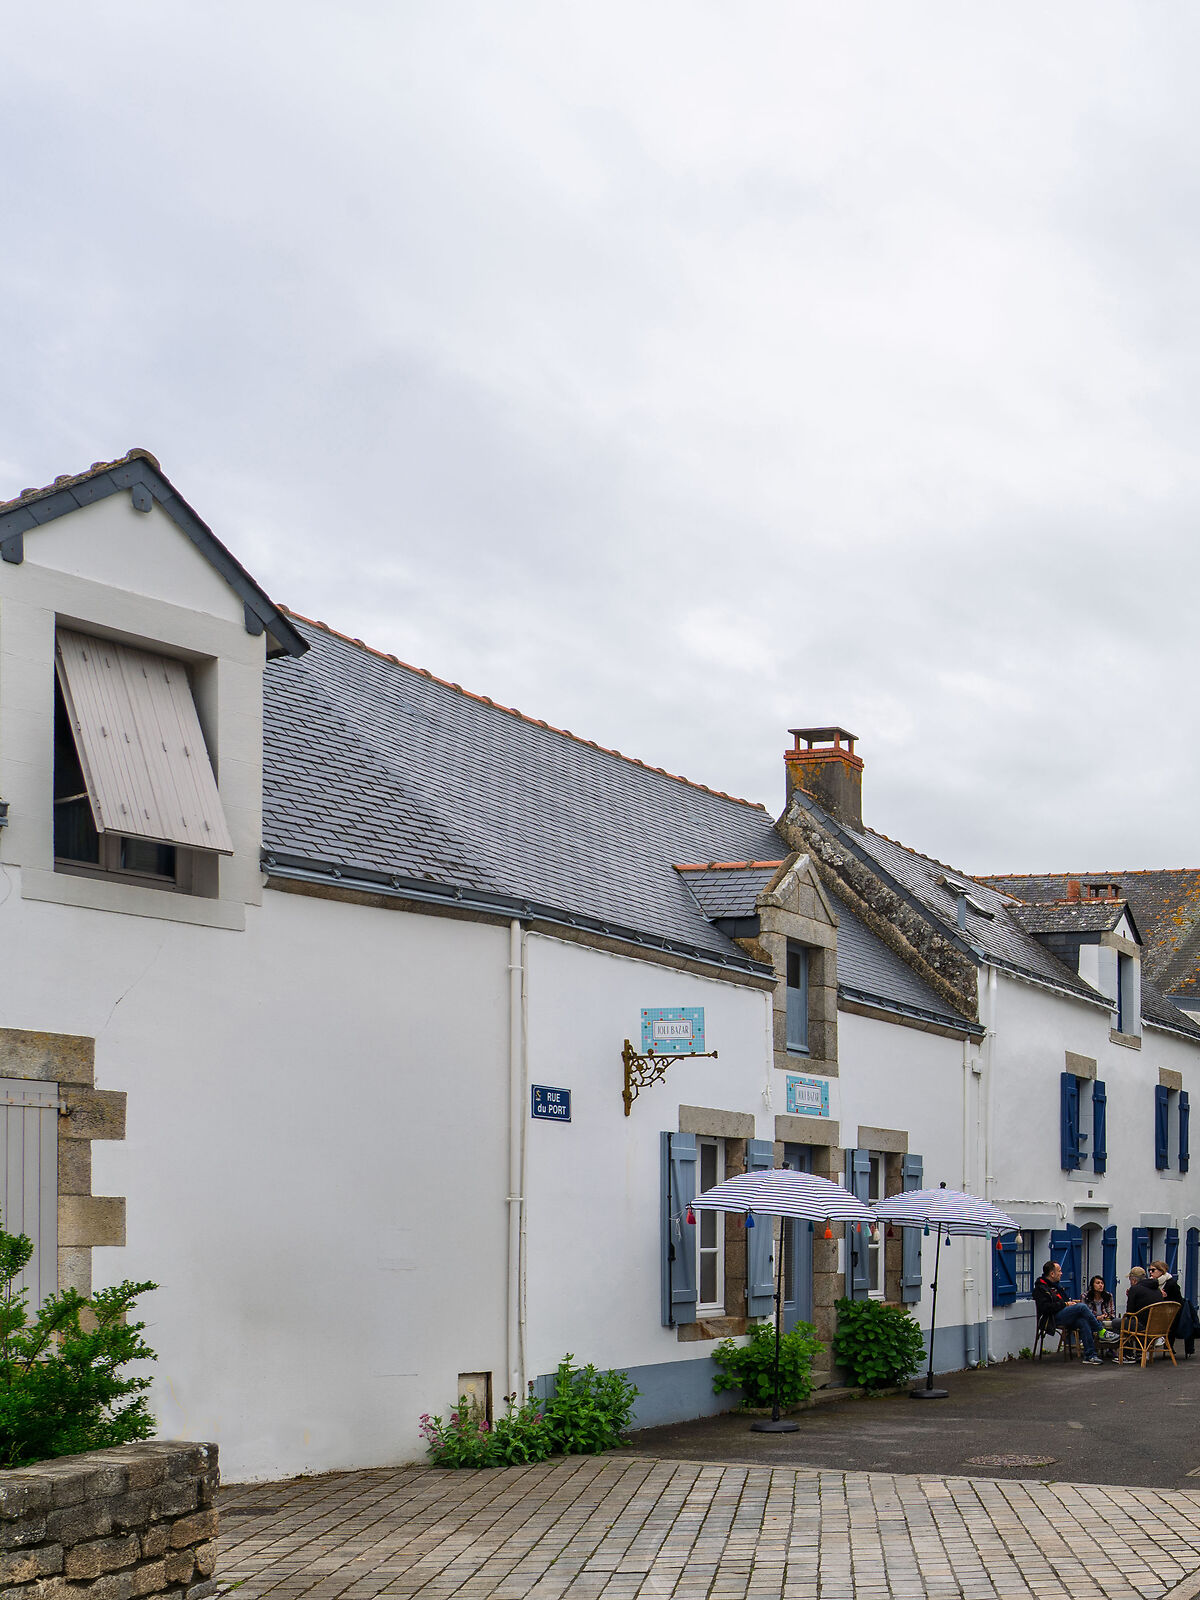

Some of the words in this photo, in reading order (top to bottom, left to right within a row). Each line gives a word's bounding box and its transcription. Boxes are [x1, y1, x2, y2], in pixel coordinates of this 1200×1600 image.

[657, 1025, 669, 1034] JOLI
[670, 1025, 689, 1034] BAZAR
[547, 1092, 561, 1103] RUE
[537, 1104, 546, 1113] du
[548, 1104, 566, 1115] PORT
